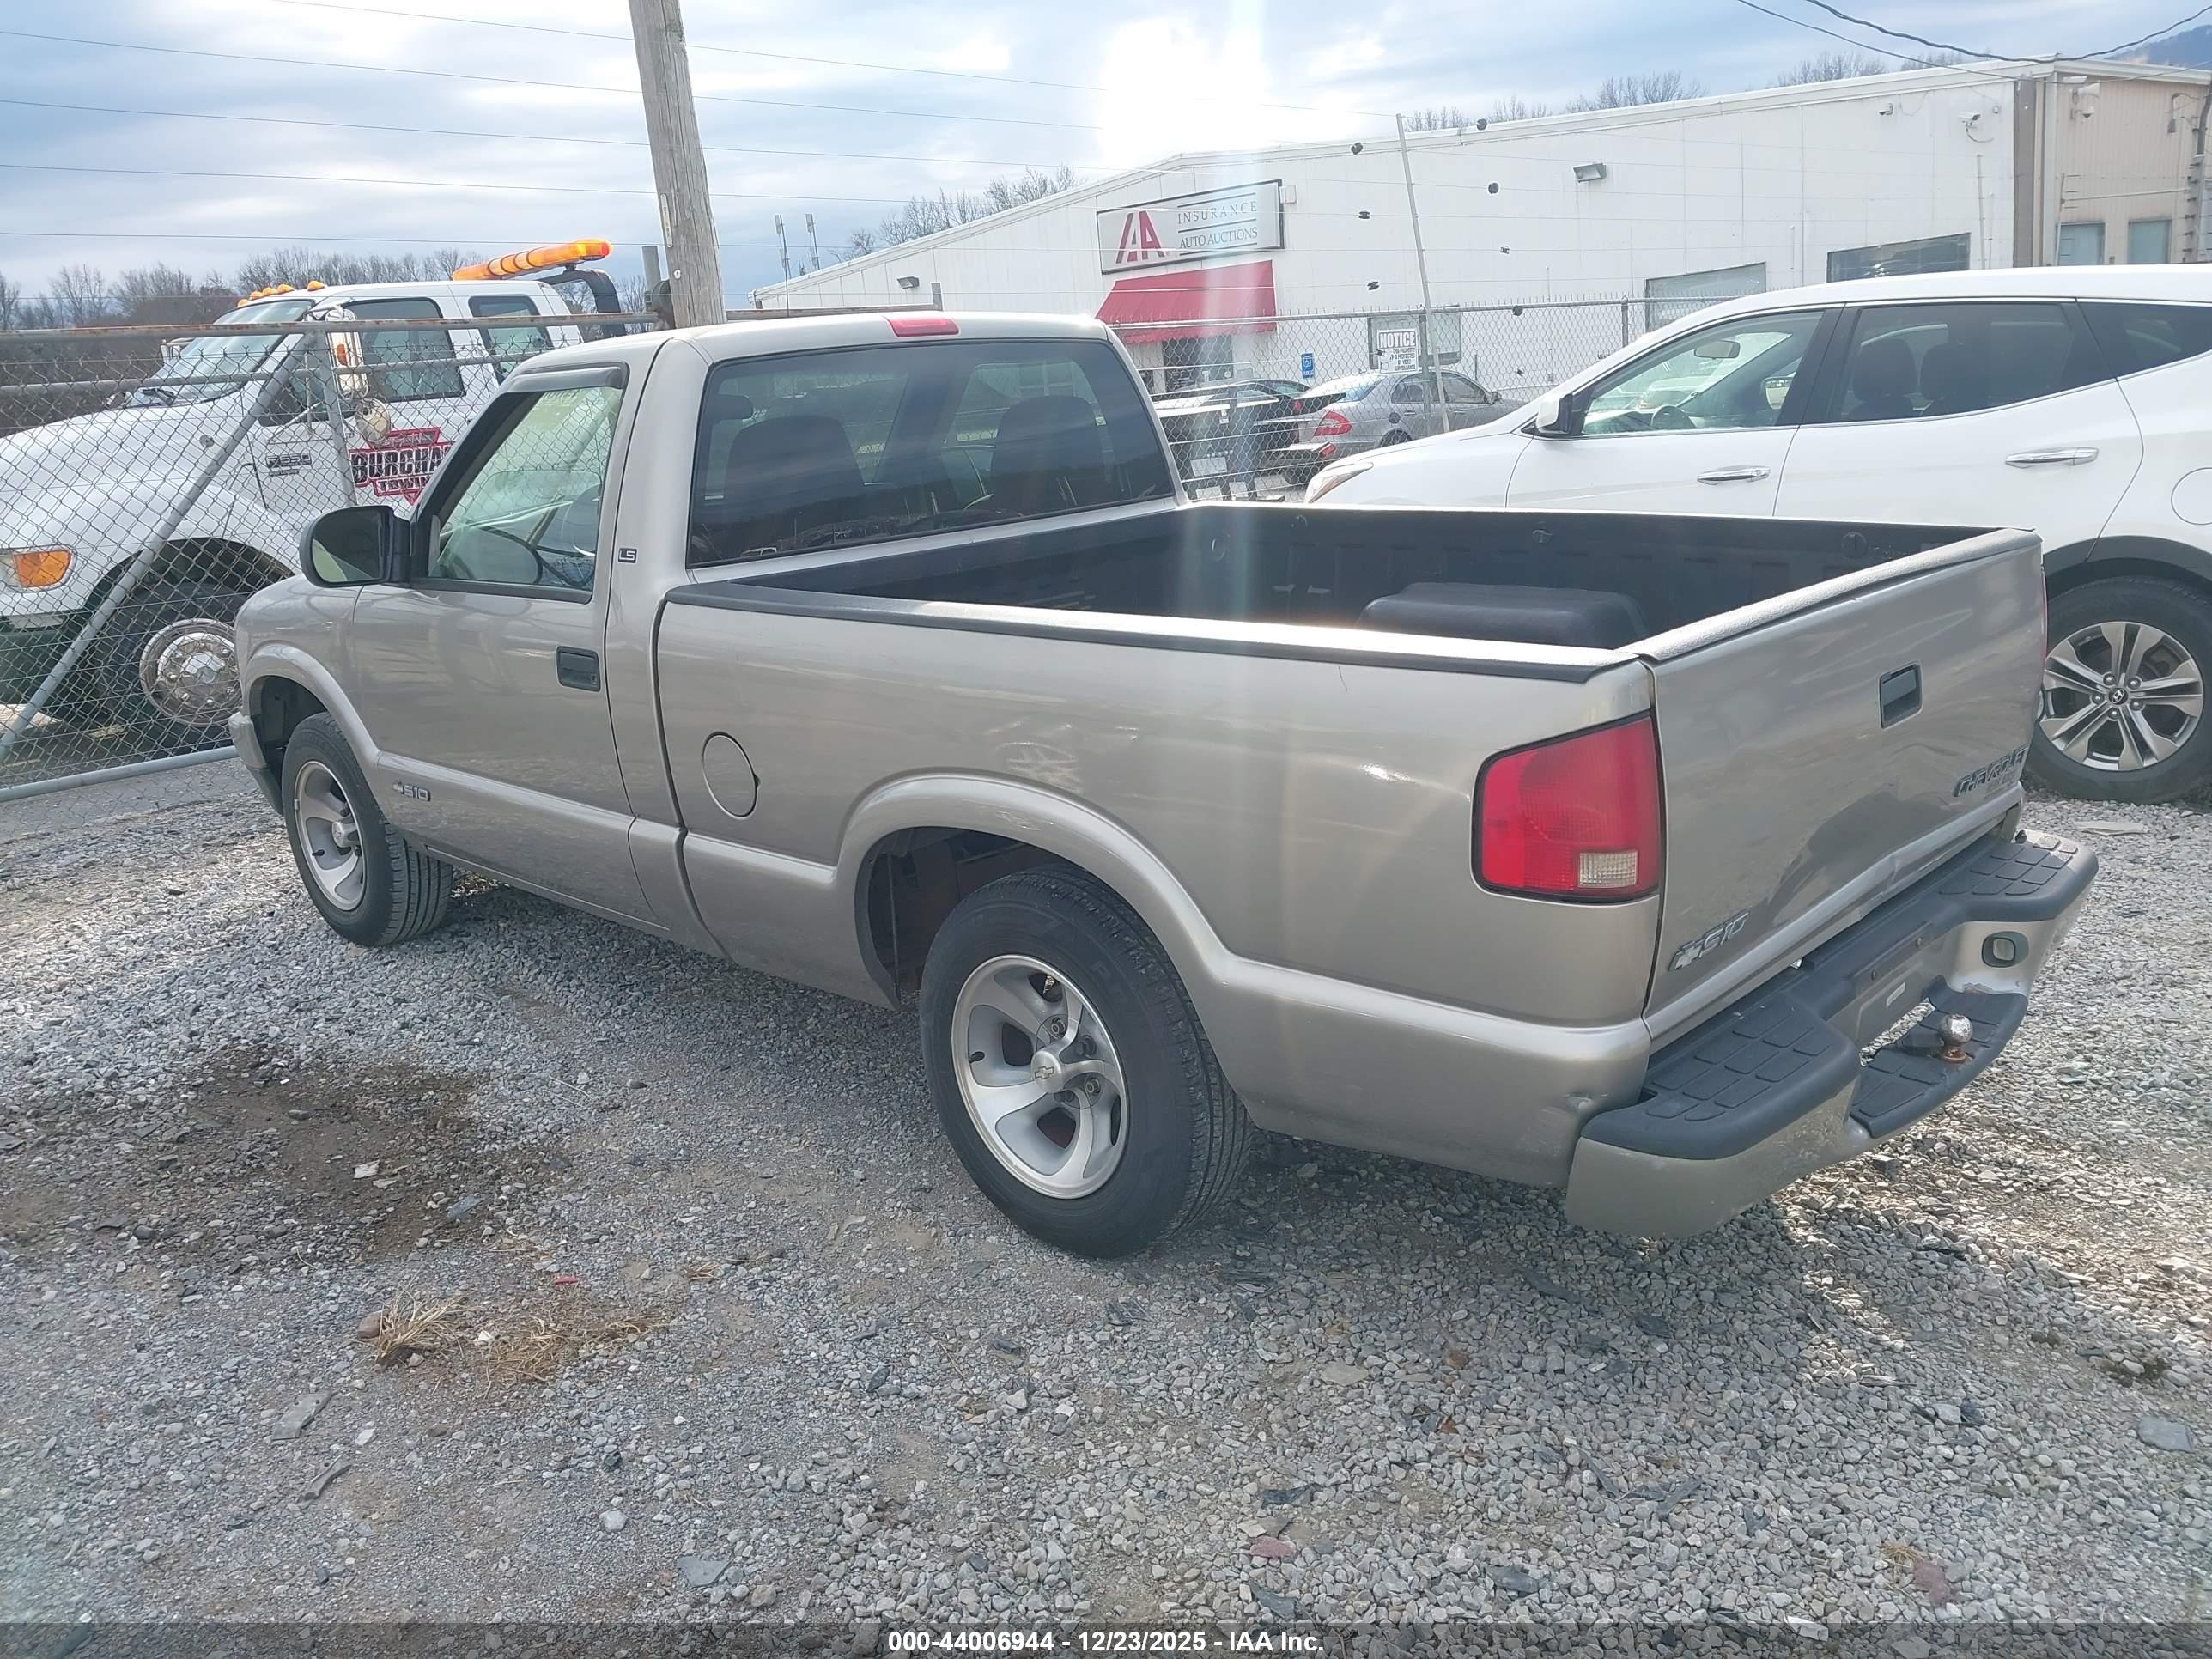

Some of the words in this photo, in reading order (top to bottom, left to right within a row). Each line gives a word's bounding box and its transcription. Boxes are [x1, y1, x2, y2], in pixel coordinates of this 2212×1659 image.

[1177, 200, 1257, 224] INSURANCE
[1180, 234, 1206, 249] AUTO
[1207, 227, 1258, 246] AUCTIONS
[1379, 331, 1416, 348] NOTICE
[619, 550, 635, 560] LS
[1955, 744, 2028, 797] CHEVROLE
[403, 783, 429, 801] S10
[1699, 910, 1750, 958] S10
